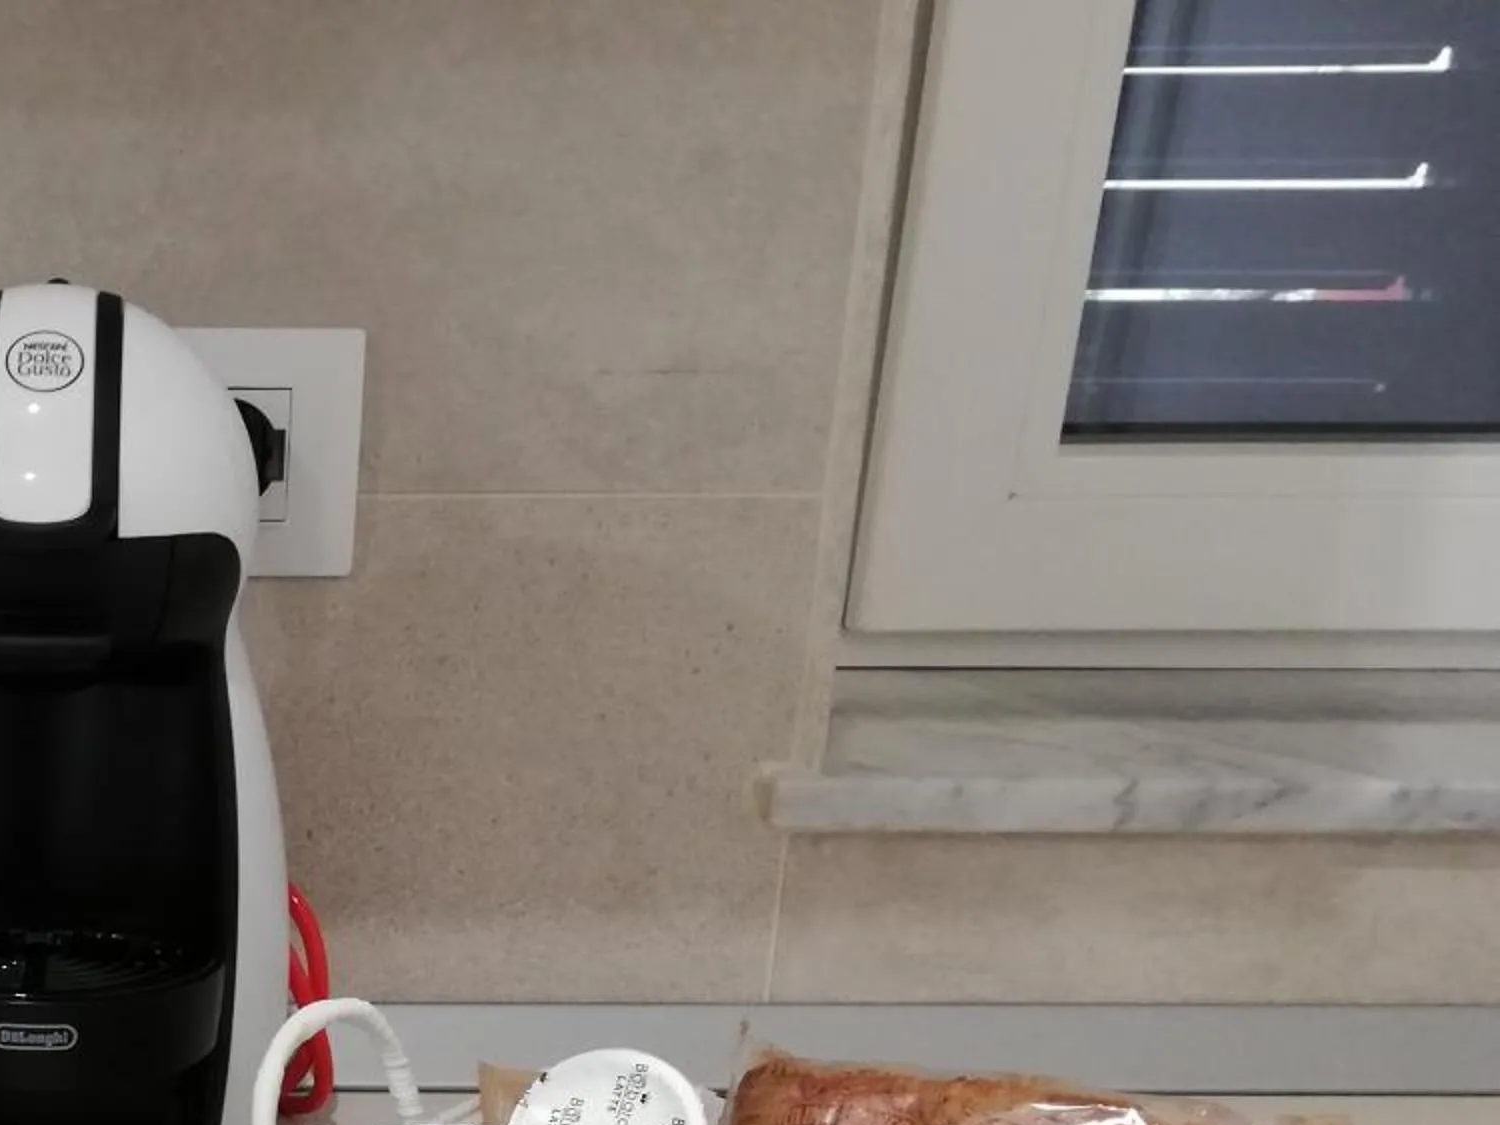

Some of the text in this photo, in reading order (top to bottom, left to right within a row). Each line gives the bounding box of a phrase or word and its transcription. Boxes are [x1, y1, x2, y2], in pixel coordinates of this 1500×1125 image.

[18, 350, 72, 364] Dolce
[18, 363, 72, 377] Gusto
[607, 1075, 627, 1112] LATTE
